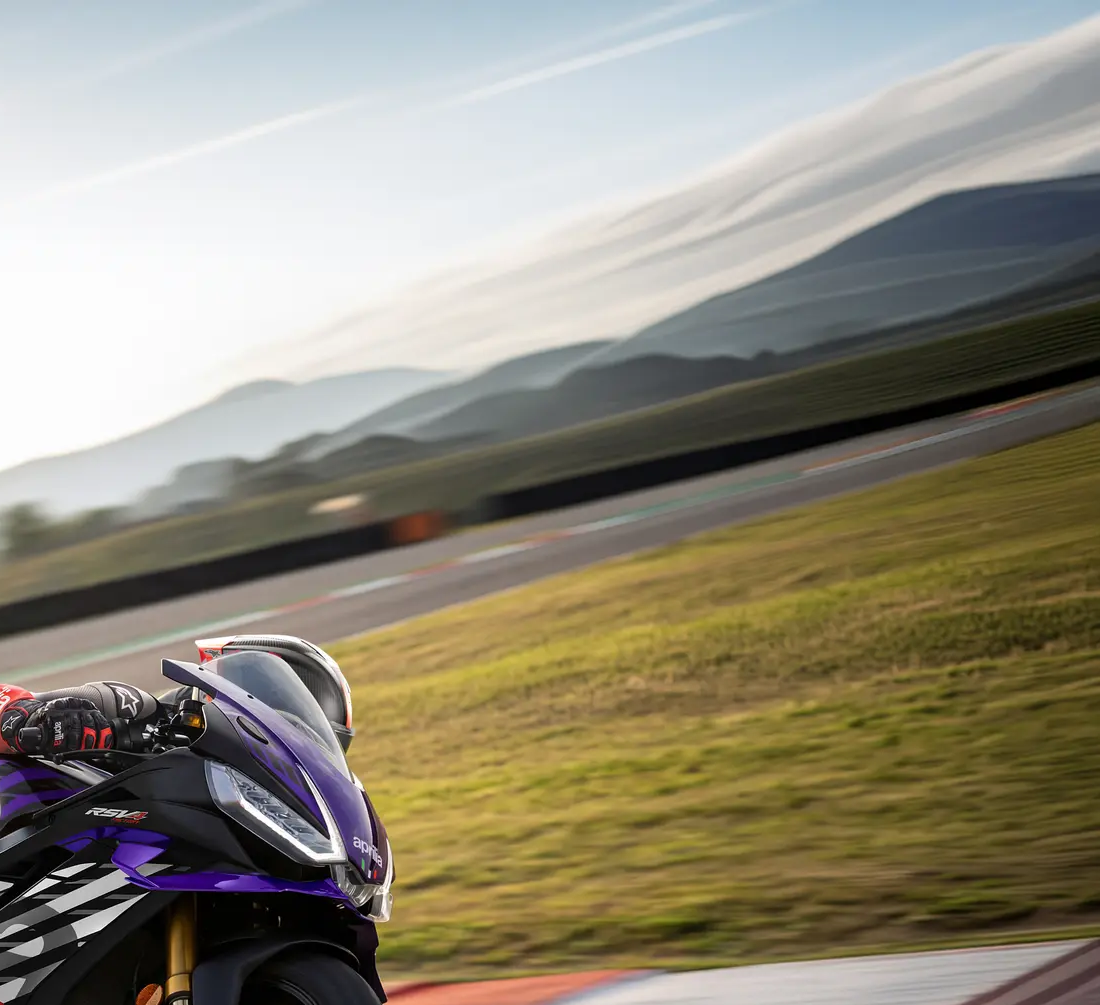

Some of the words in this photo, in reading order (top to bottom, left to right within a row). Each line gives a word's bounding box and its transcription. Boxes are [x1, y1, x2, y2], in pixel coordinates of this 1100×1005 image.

[54, 721, 64, 747] aprilia
[85, 807, 148, 820] RSV4
[353, 836, 383, 868] aprilia
